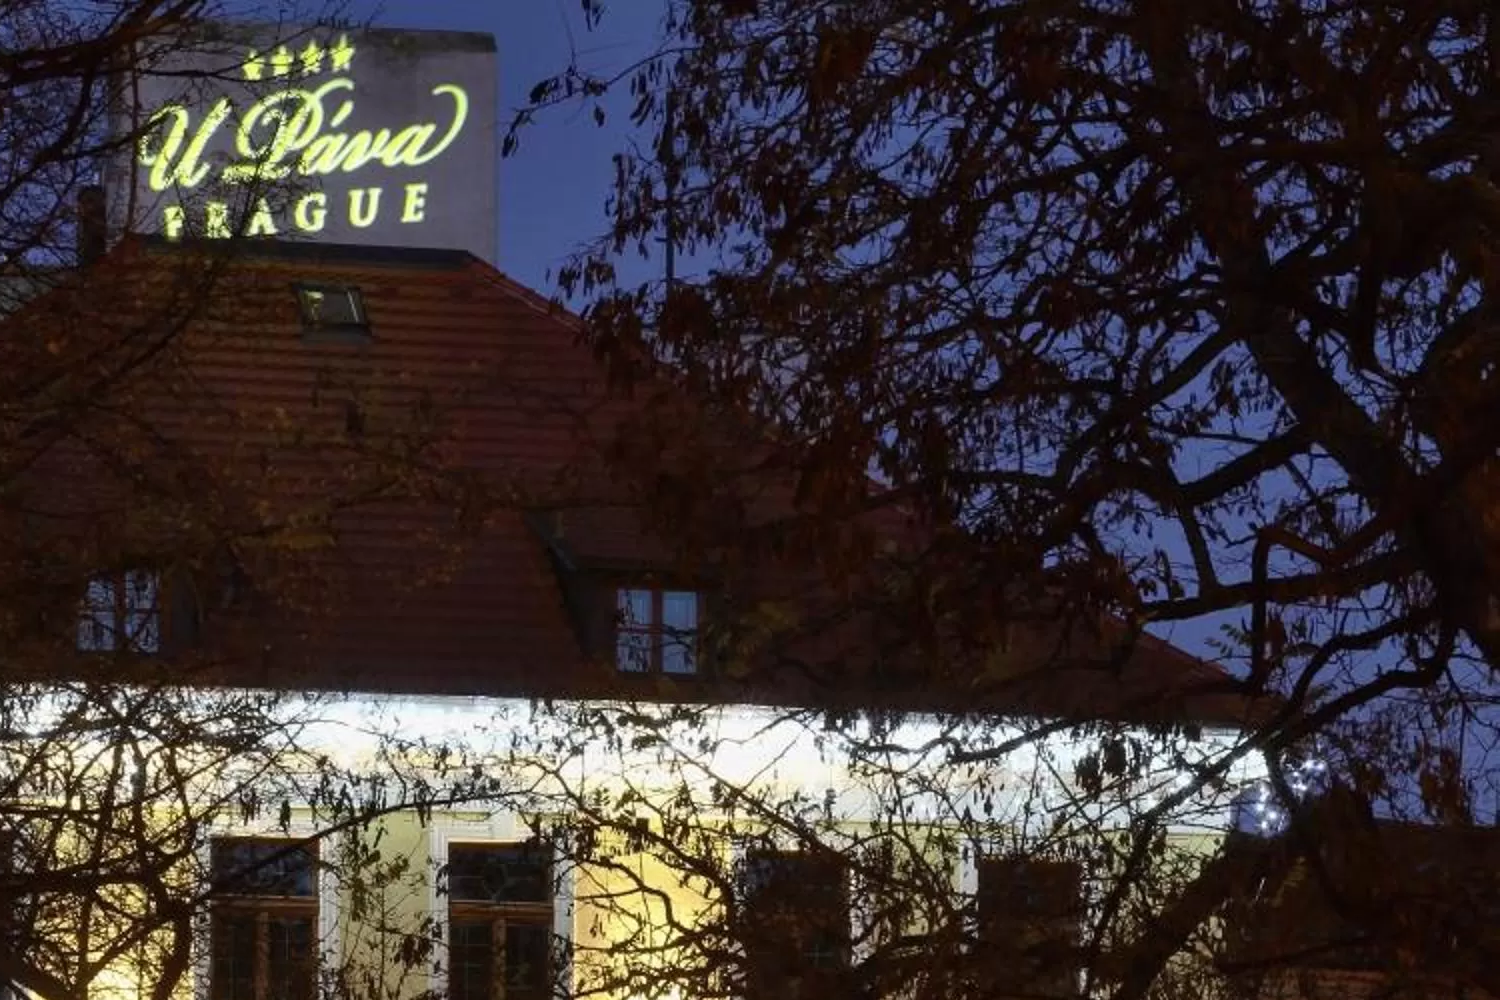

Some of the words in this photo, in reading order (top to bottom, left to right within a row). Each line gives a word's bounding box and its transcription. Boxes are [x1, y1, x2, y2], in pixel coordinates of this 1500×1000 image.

[137, 98, 232, 191] U
[221, 77, 469, 184] Páva
[163, 182, 429, 242] PRAGUE
